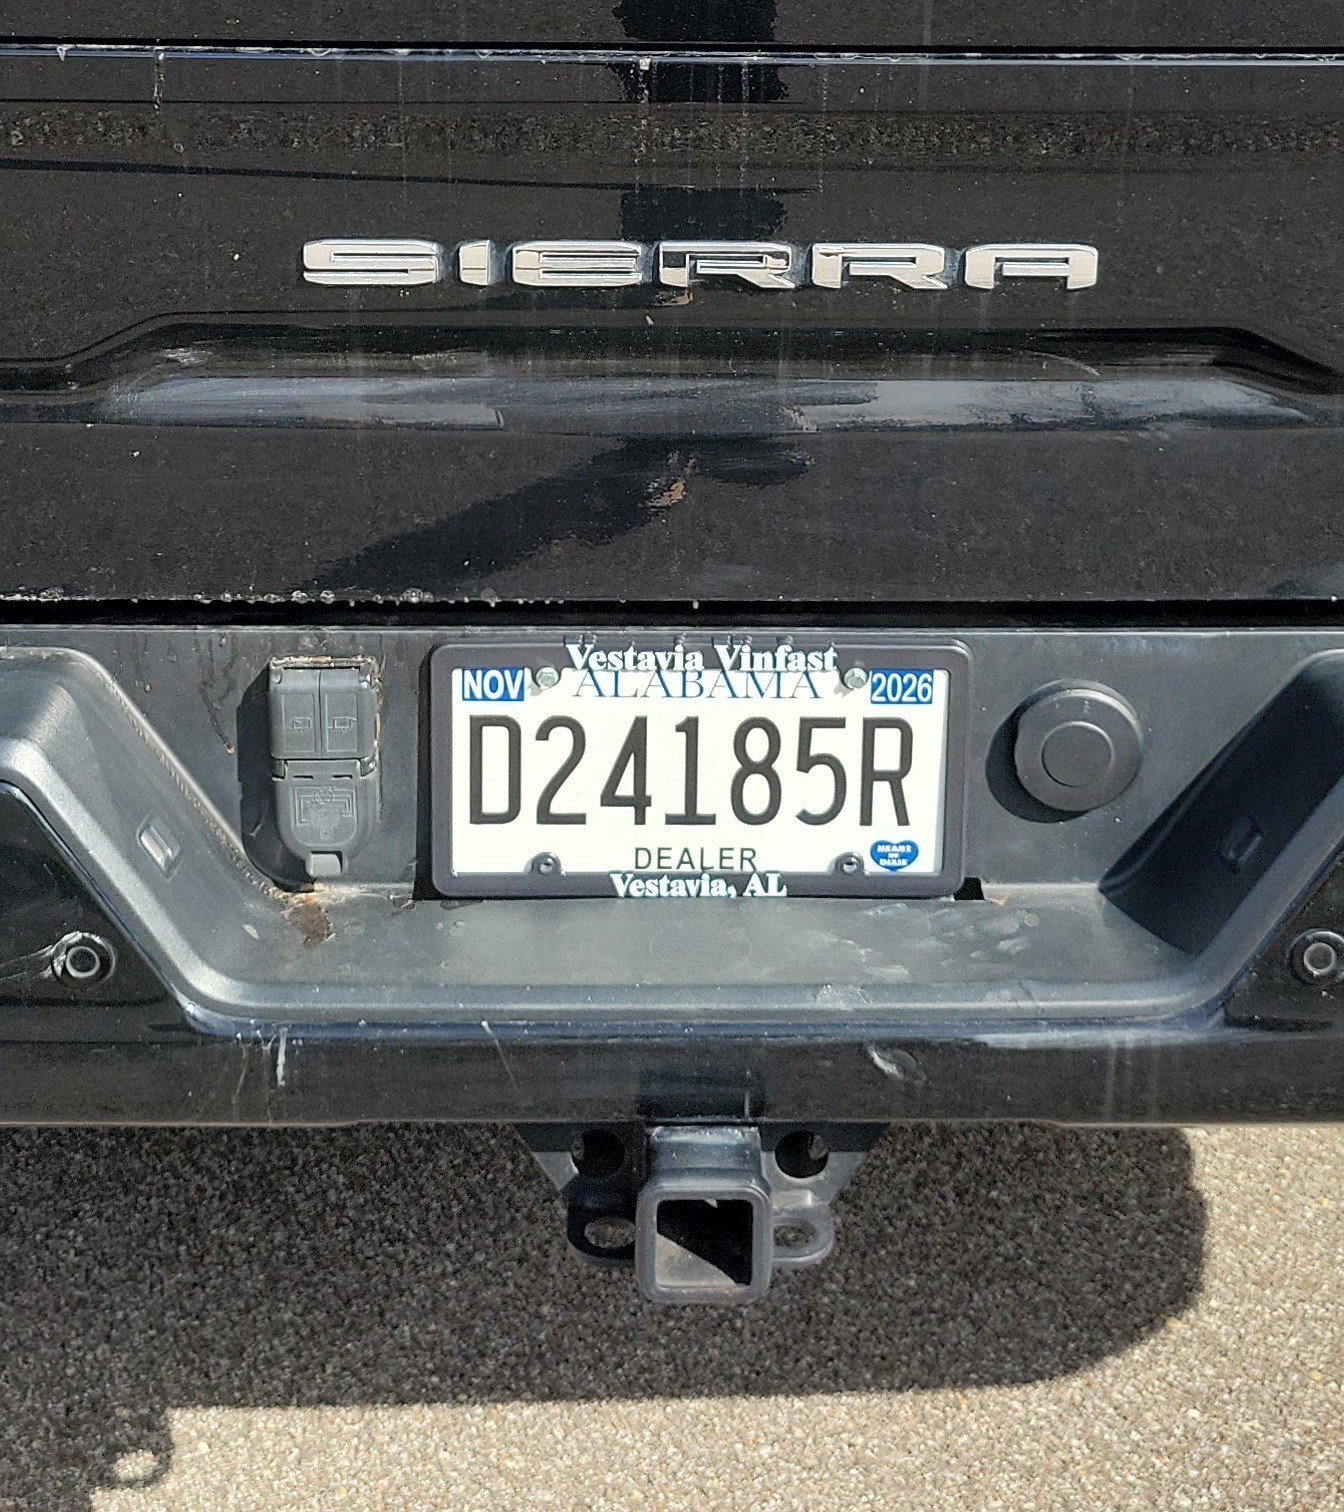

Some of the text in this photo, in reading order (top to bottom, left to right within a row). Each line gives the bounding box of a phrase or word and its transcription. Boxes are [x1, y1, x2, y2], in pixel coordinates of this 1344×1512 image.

[302, 238, 1099, 292] SIERRA
[565, 643, 838, 672] Vestavia Vinfast
[462, 672, 524, 700] NOV
[571, 669, 824, 699] ALABAMA
[870, 674, 932, 703] 2026
[467, 714, 914, 827] D24185R
[634, 846, 758, 871] DEALER
[609, 872, 788, 899] Vestavia, AL
